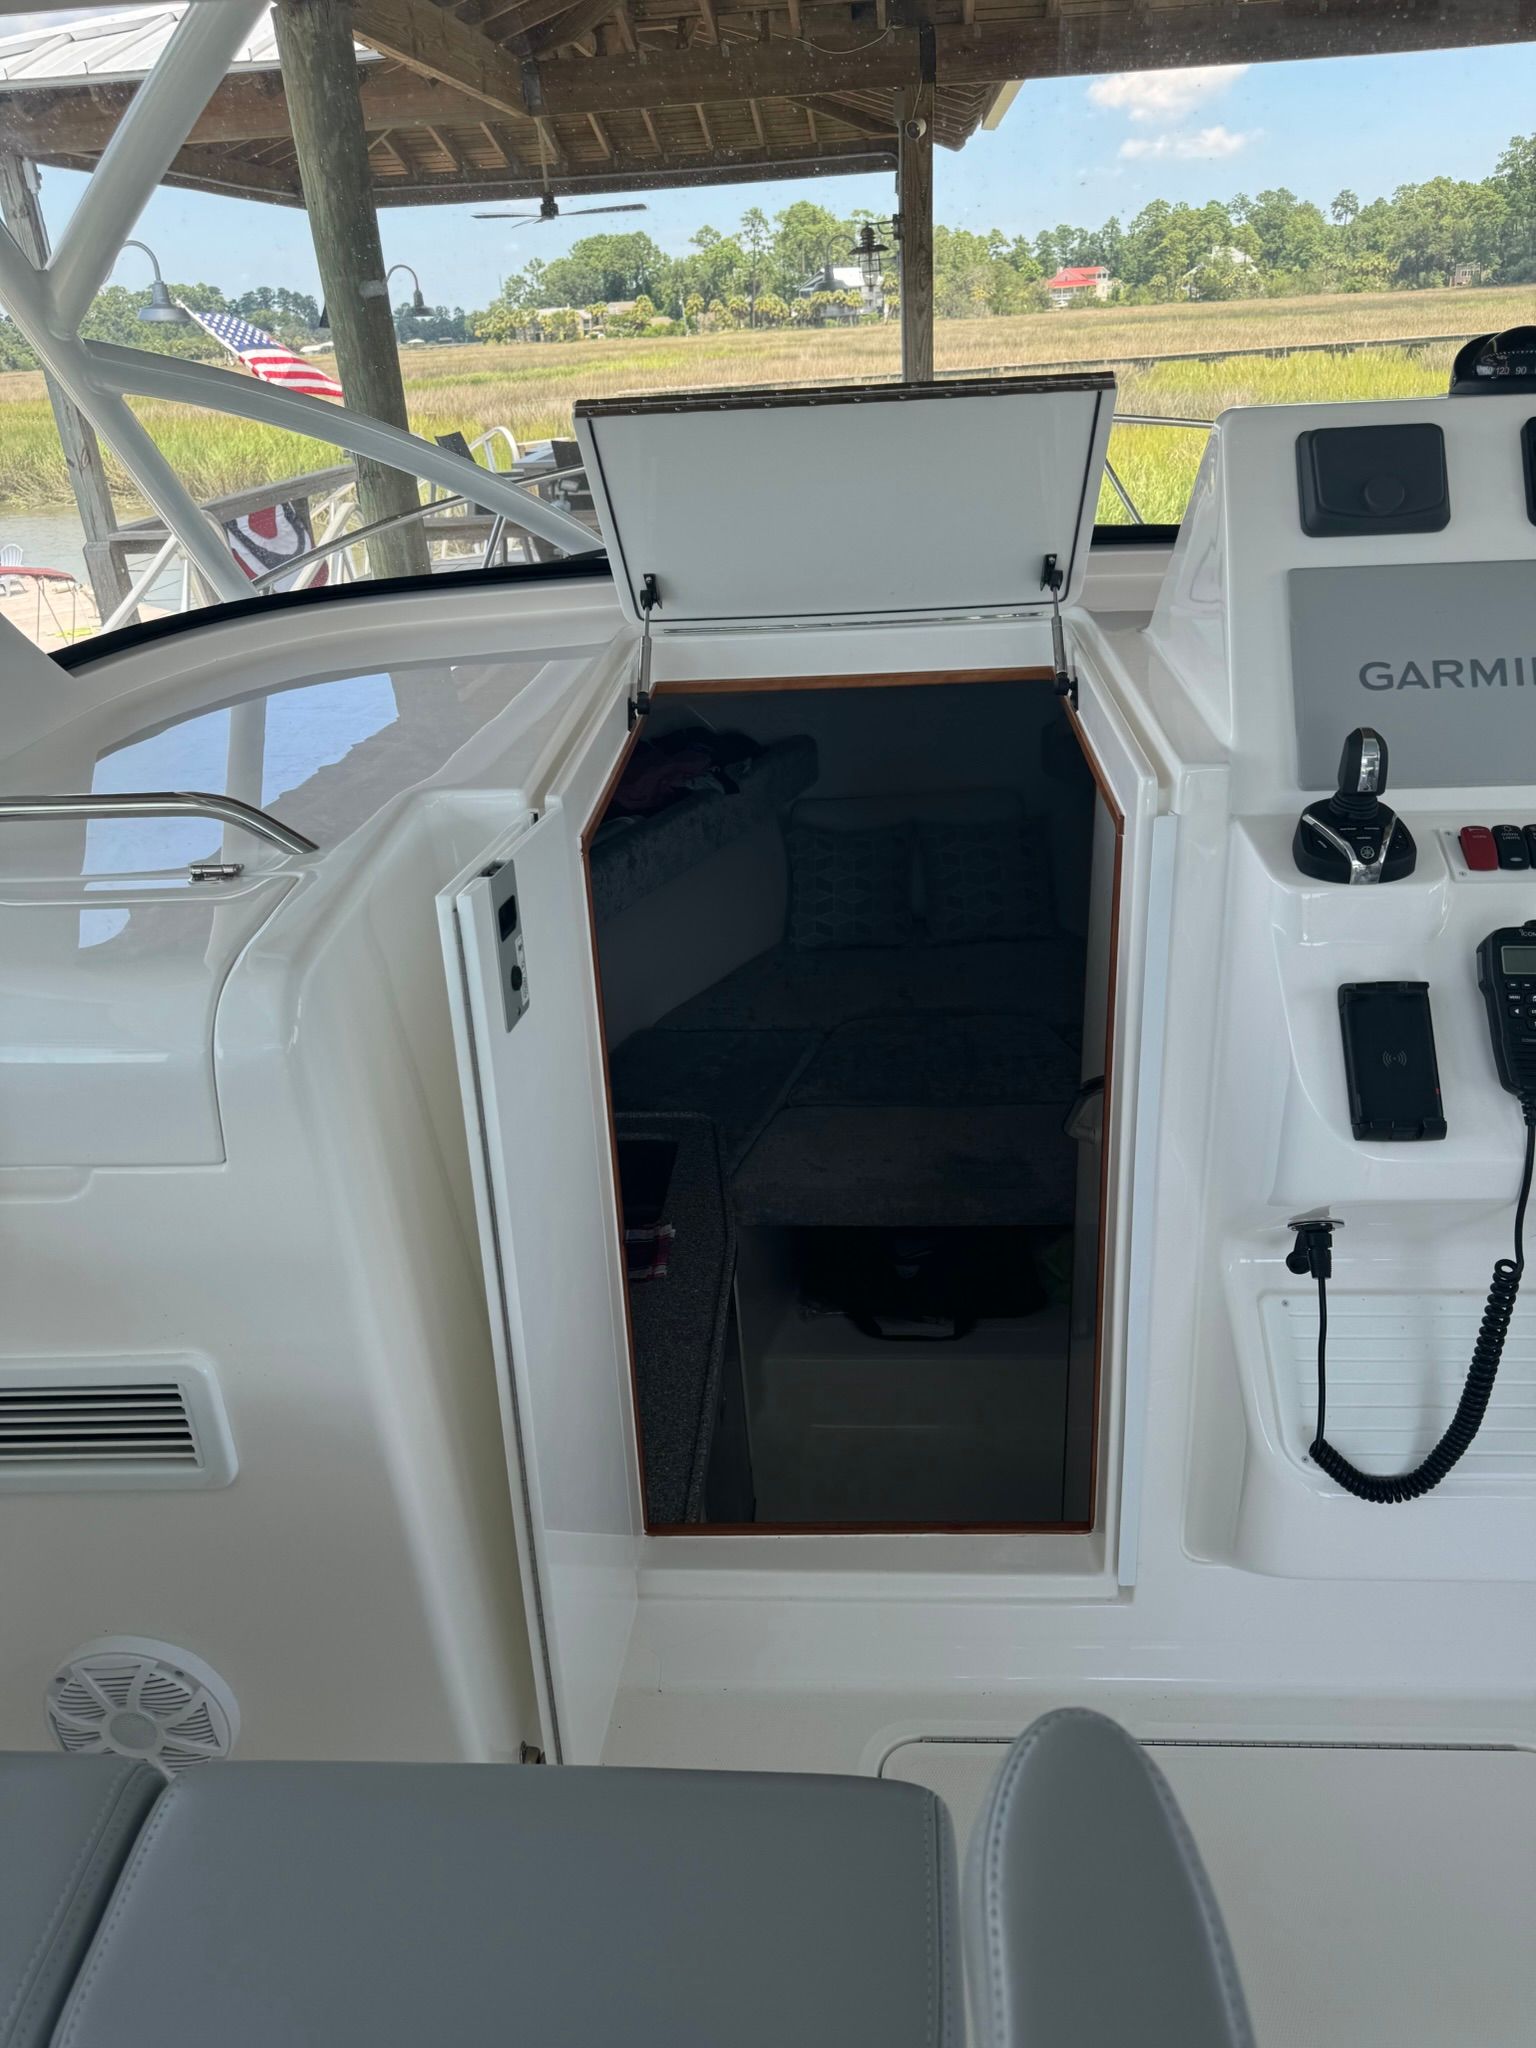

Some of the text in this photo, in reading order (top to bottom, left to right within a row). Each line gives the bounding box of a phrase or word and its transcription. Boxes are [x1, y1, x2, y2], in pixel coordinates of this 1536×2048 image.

[1496, 366, 1510, 375] 120
[1515, 366, 1527, 375] 90
[1358, 657, 1536, 691] GARMI
